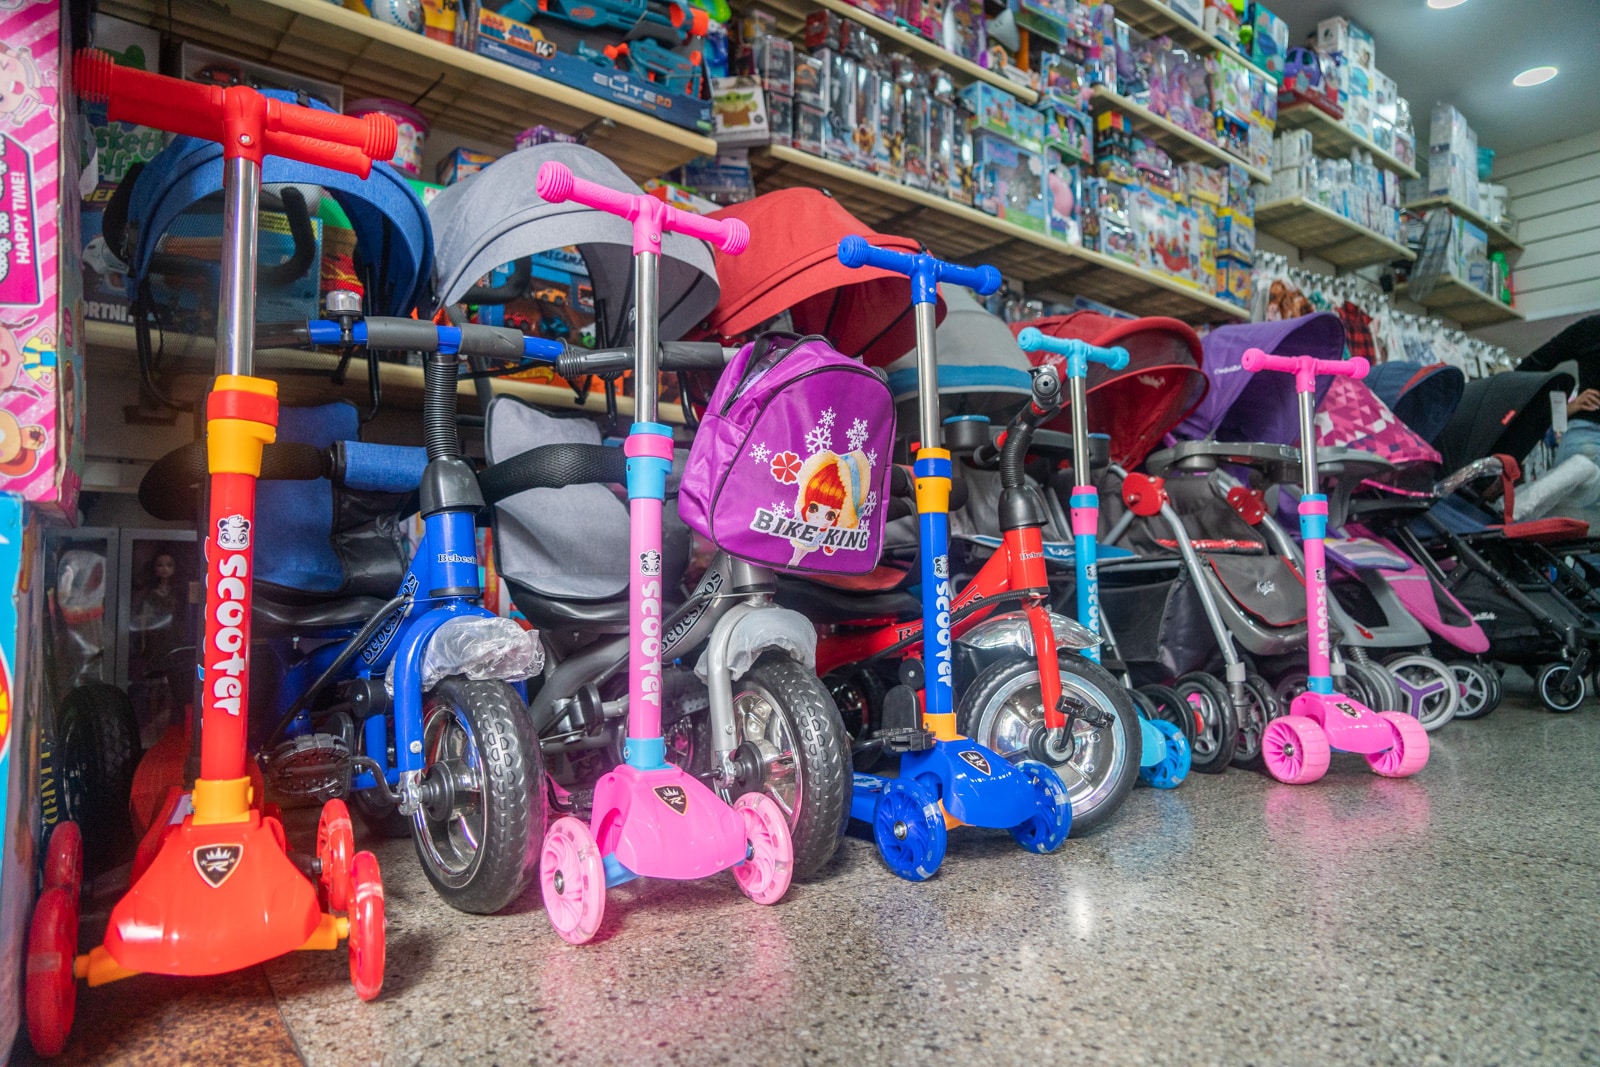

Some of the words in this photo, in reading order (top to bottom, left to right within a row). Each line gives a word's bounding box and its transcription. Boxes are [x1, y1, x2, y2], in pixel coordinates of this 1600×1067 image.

[593, 72, 656, 102] ELITE
[10, 171, 26, 211] TIME!
[14, 212, 30, 265] HAPPY
[753, 509, 818, 542] BIKE
[822, 529, 868, 549] KING
[212, 554, 247, 716] scooter
[640, 580, 661, 706] scooter
[936, 581, 952, 687] scooter
